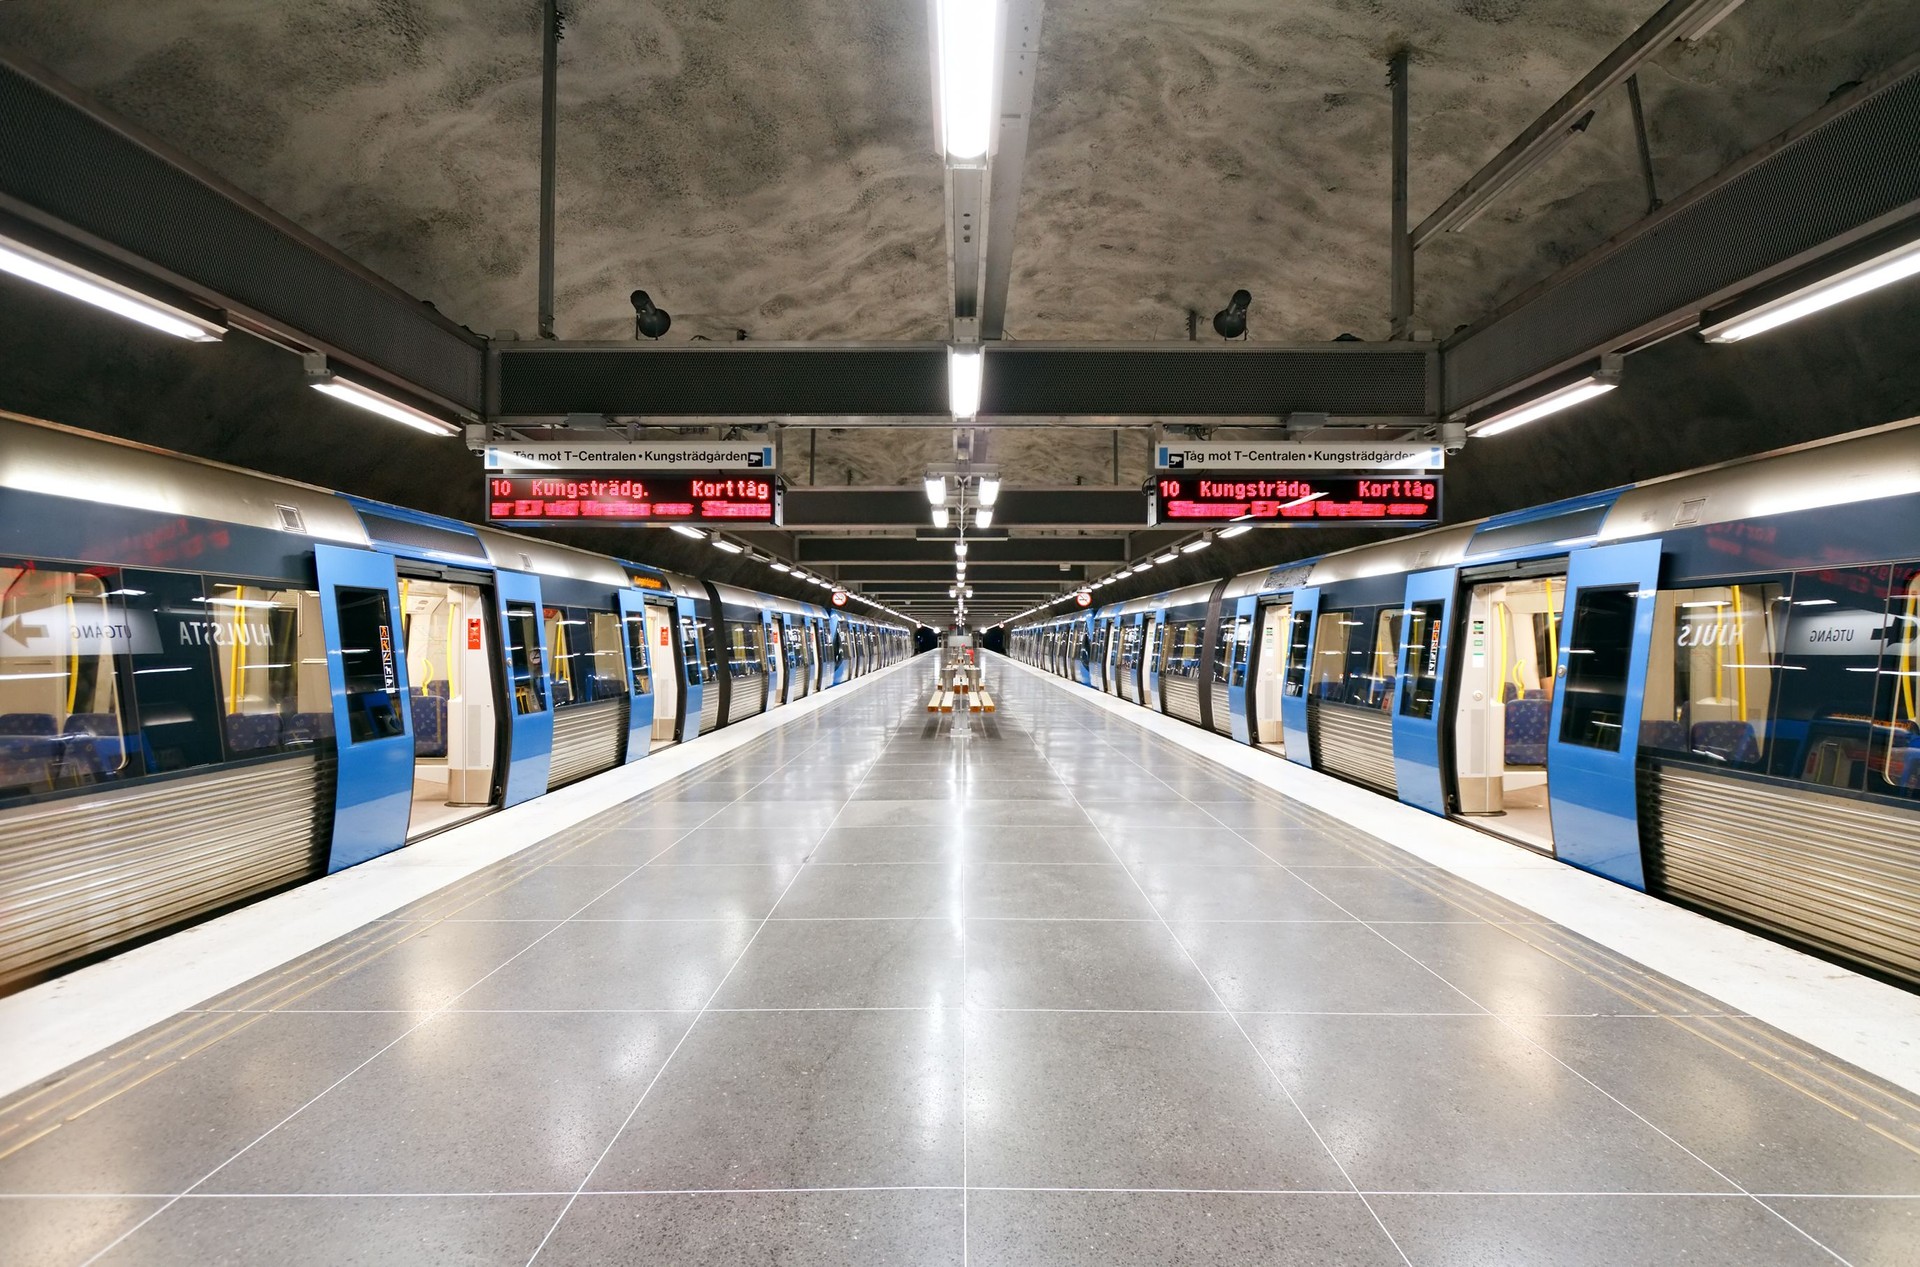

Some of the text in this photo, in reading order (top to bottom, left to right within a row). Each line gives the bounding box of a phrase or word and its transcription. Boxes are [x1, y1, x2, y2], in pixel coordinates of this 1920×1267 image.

[538, 451, 562, 461] mot
[564, 451, 637, 461] T-Centralen
[644, 451, 747, 463] Kungsträdgården
[1183, 451, 1205, 463] Tåg
[1208, 451, 1232, 461] mot
[1234, 451, 1306, 461] T-Centralen
[492, 480, 511, 496] 10
[532, 480, 649, 499] Kungsträdg.
[1160, 481, 1180, 497] 10
